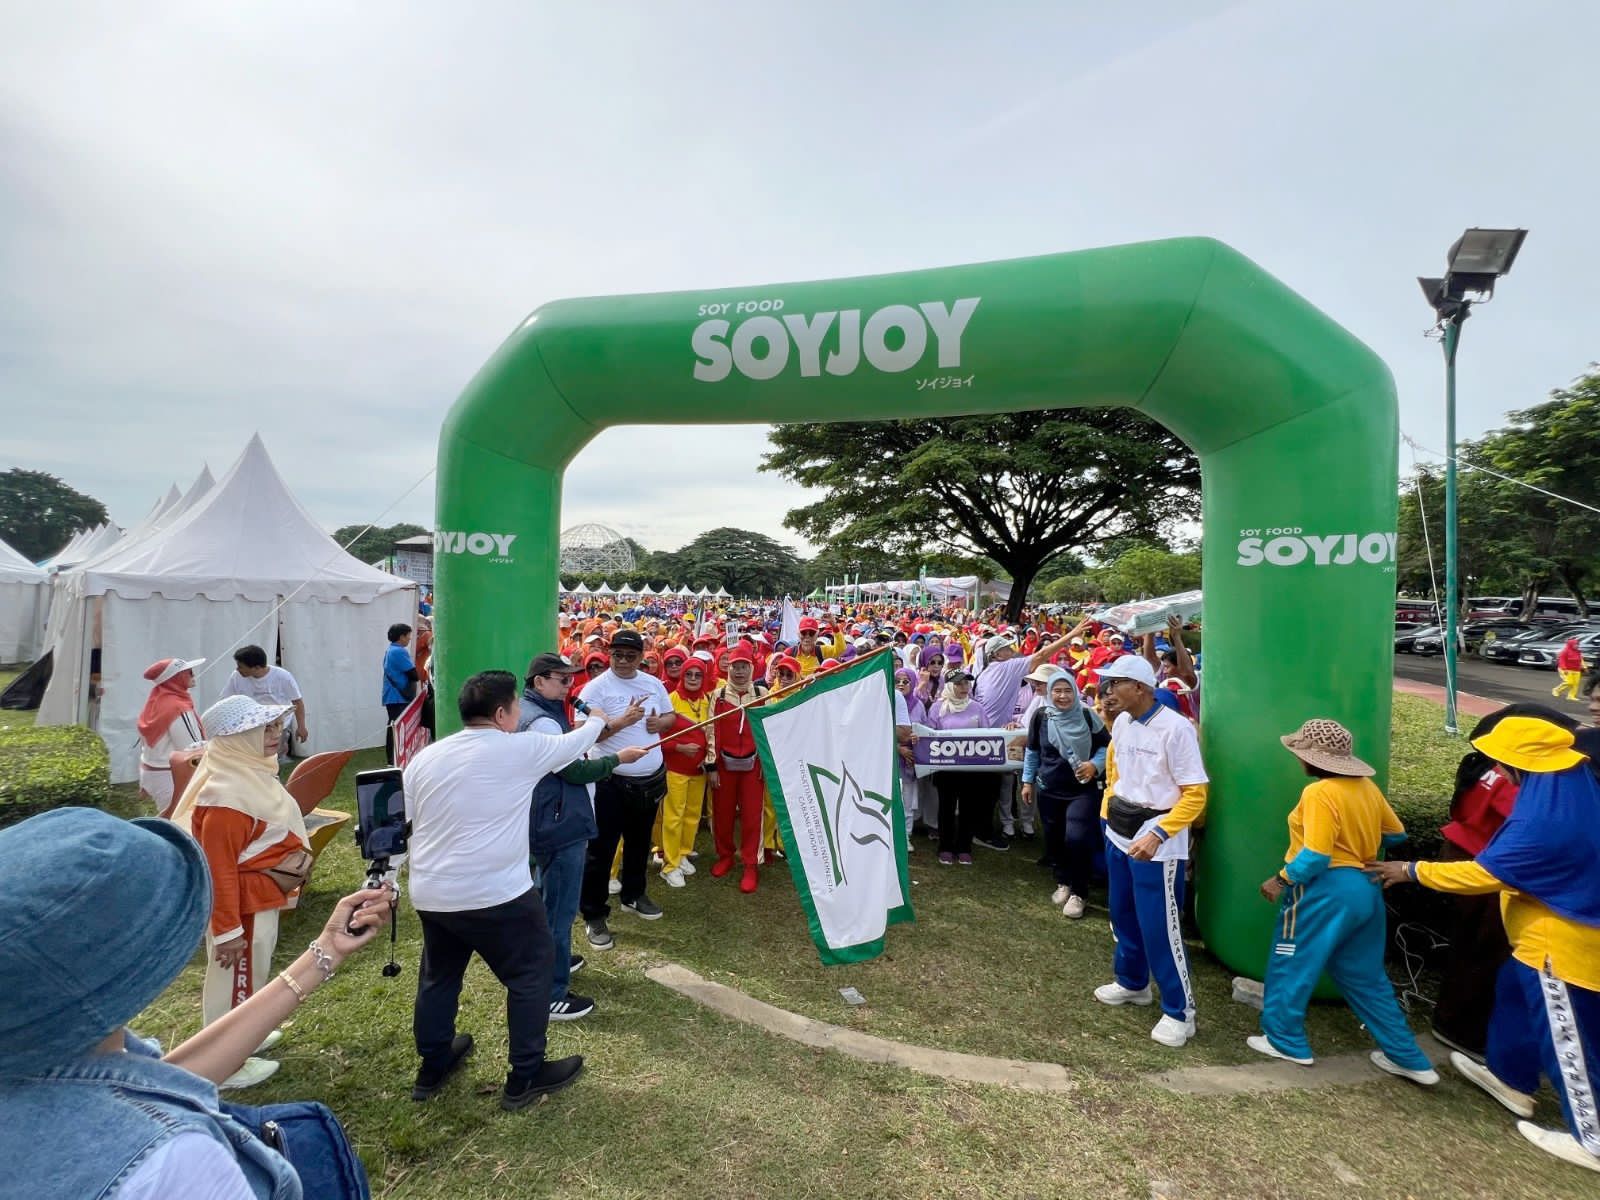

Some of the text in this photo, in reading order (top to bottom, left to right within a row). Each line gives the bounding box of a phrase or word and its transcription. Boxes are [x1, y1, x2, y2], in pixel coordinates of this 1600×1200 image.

[698, 299, 785, 316] SOY FOOD
[691, 297, 981, 382] SOYJOY
[916, 375, 975, 391] ソイジョイ
[1240, 527, 1303, 537] SOY FOOD
[929, 740, 1004, 757] SOYJOY
[798, 796, 819, 857] CABANG BOGOR
[810, 805, 825, 845] DIABETES
[820, 845, 834, 893] INDONESIA
